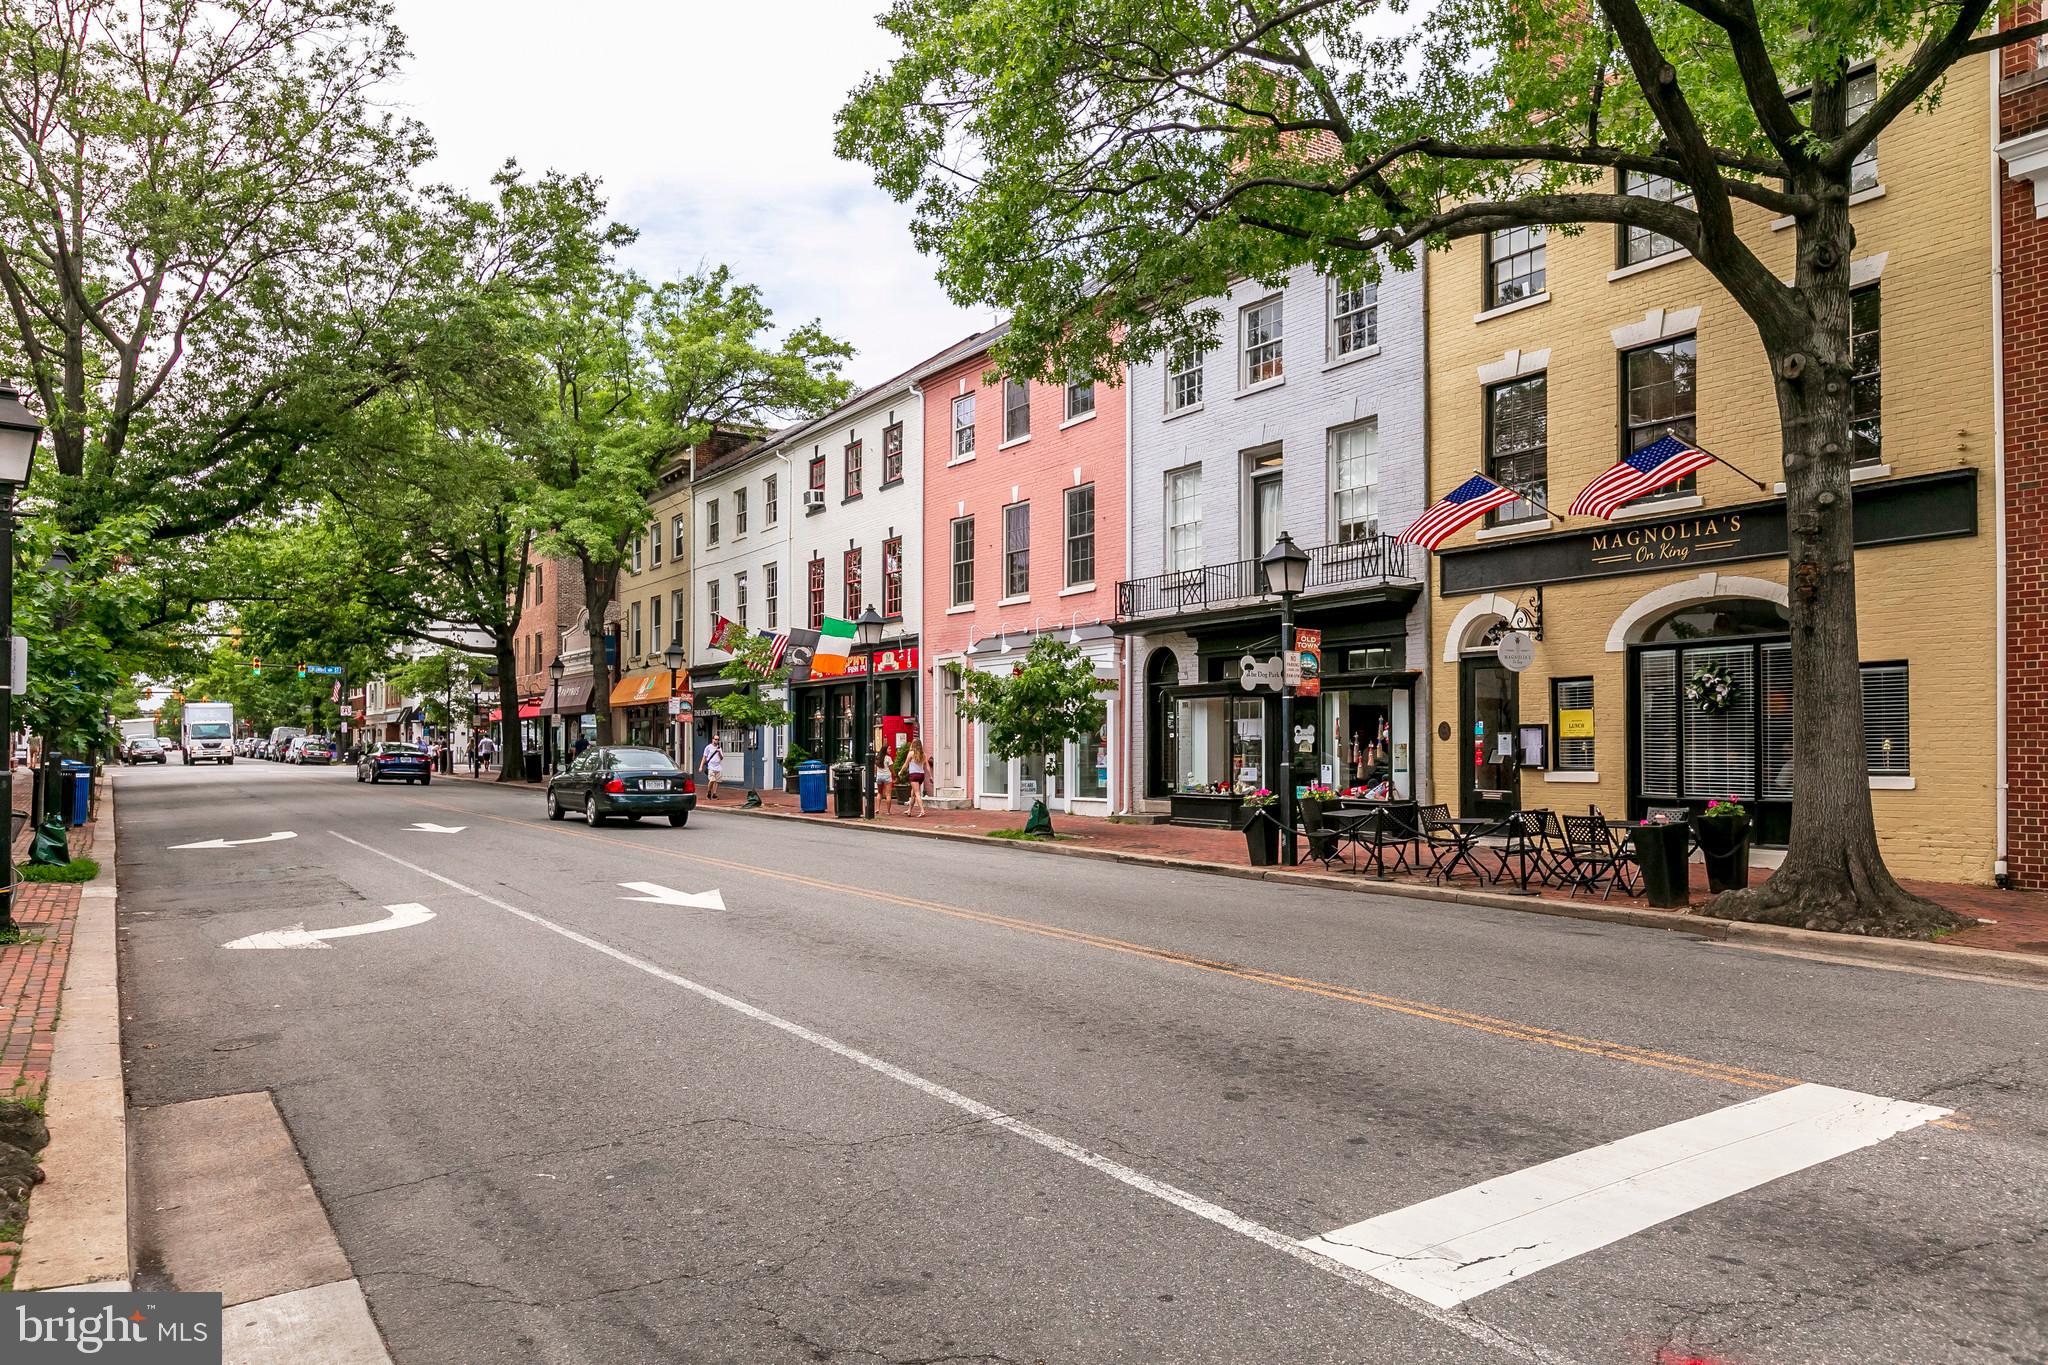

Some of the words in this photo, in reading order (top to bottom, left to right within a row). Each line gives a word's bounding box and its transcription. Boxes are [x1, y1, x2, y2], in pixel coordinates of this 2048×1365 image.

[1592, 515, 1741, 551] MAGNOLIA'S
[1636, 545, 1655, 563] On
[1659, 542, 1689, 560] King
[1257, 671, 1268, 679] Dog
